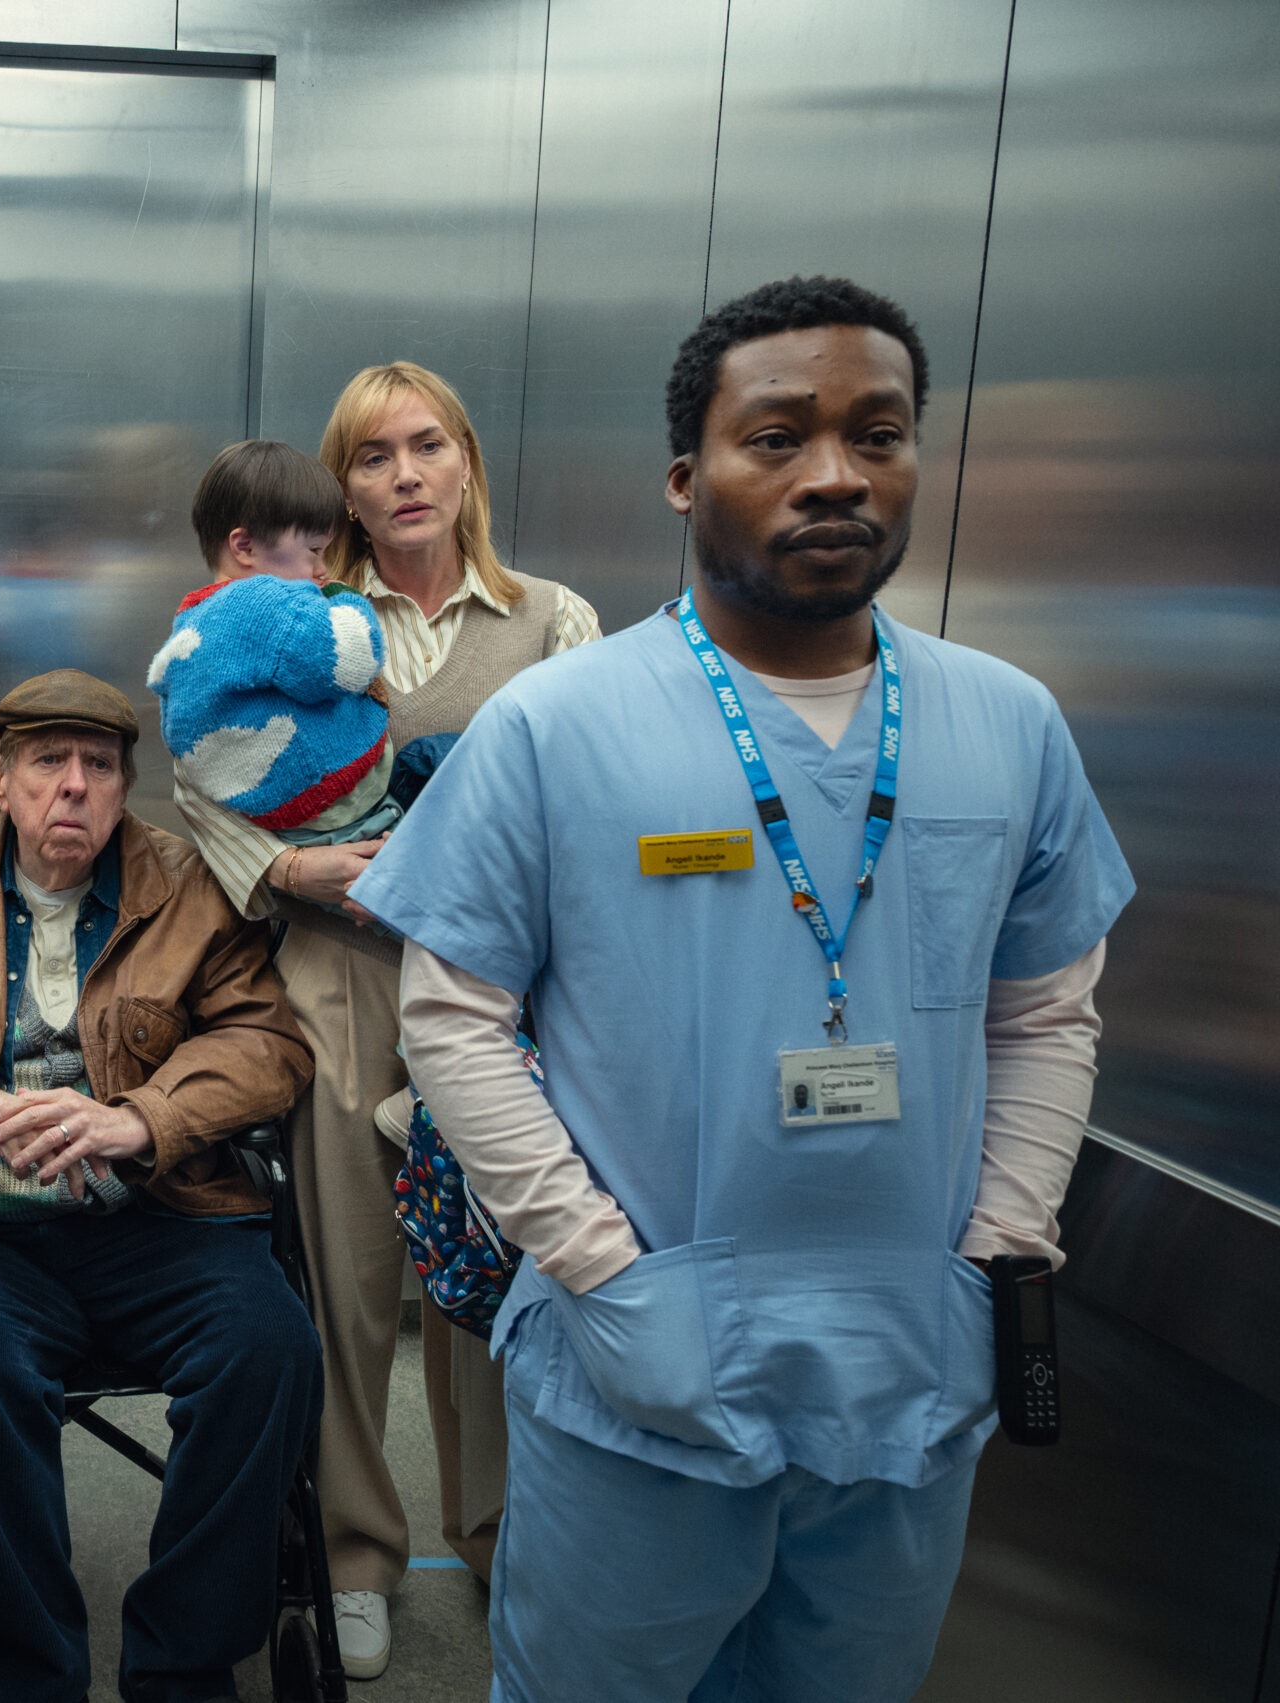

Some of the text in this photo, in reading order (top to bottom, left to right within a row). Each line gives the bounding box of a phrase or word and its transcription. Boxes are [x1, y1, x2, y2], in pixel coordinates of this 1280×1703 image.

[683, 618, 707, 645] NHS
[698, 650, 725, 677] NHS
[882, 646, 898, 675] NHS
[716, 686, 743, 718] NHS
[886, 682, 901, 716] NHS
[733, 729, 760, 763] NHS
[883, 724, 899, 761] NHS
[783, 858, 812, 892] NHS
